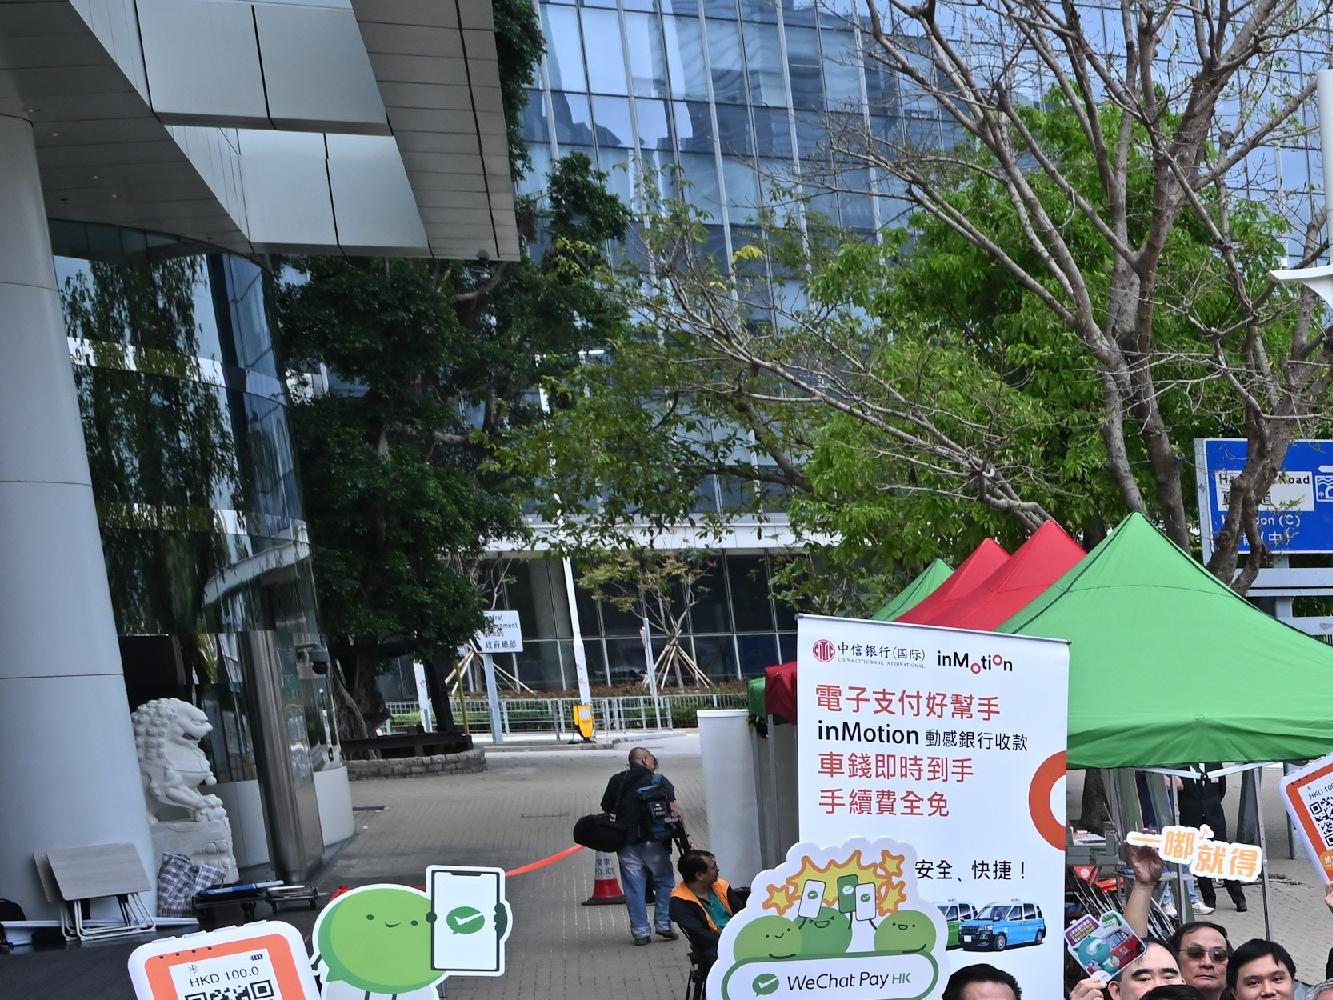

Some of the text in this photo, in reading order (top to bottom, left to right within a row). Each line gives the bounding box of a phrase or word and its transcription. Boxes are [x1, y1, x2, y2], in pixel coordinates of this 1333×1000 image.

[937, 649, 1013, 675] inMotion
[815, 684, 1001, 721] 電子支付好幫手
[817, 720, 1028, 751] inMotion 動感銀行收款
[817, 752, 975, 783] 車錢即時到手
[818, 788, 950, 817] 手續費全免
[1131, 831, 1260, 877] 一嘟就得
[190, 966, 259, 988] HKD 100.0
[787, 971, 911, 991] WeChat Pay HK
